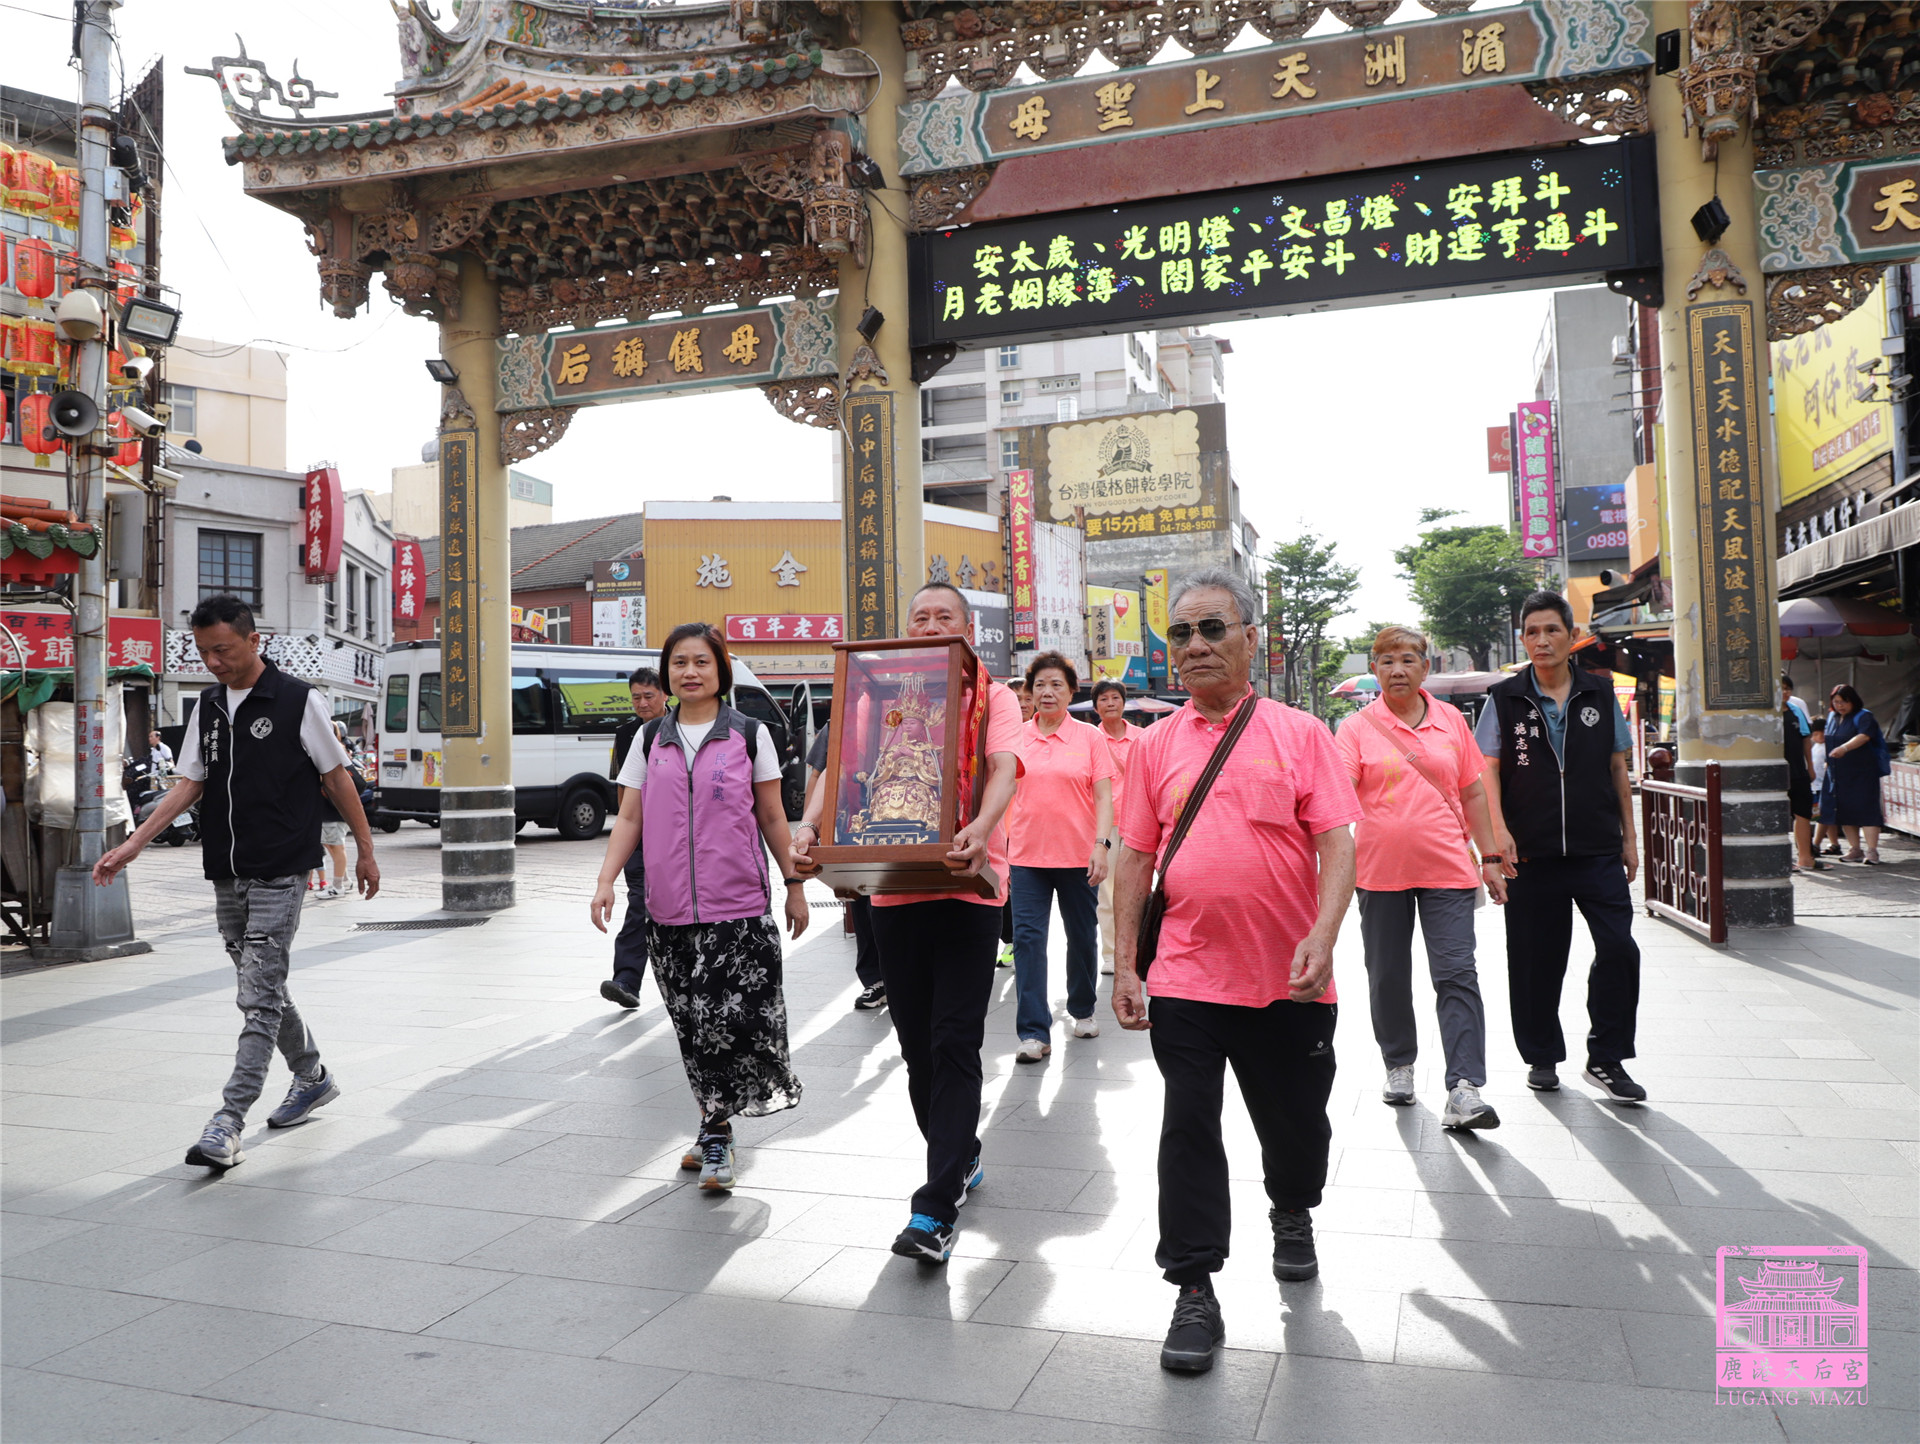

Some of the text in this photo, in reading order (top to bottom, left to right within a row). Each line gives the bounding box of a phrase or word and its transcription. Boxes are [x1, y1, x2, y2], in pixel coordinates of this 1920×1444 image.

[1058, 471, 1195, 501] 台灣優格餅乾學院
[1108, 498, 1127, 507] GOOD
[1128, 496, 1154, 506] SCHOOL
[1155, 495, 1163, 503] OF
[1163, 493, 1188, 501] COOKIE
[1158, 505, 1216, 523] 免費參觀
[1160, 519, 1217, 534] 04-758-9501
[738, 617, 840, 638] 百年老店
[1527, 708, 1540, 739] 委員
[1513, 721, 1530, 767] 施志忠
[711, 753, 728, 802] 民政處
